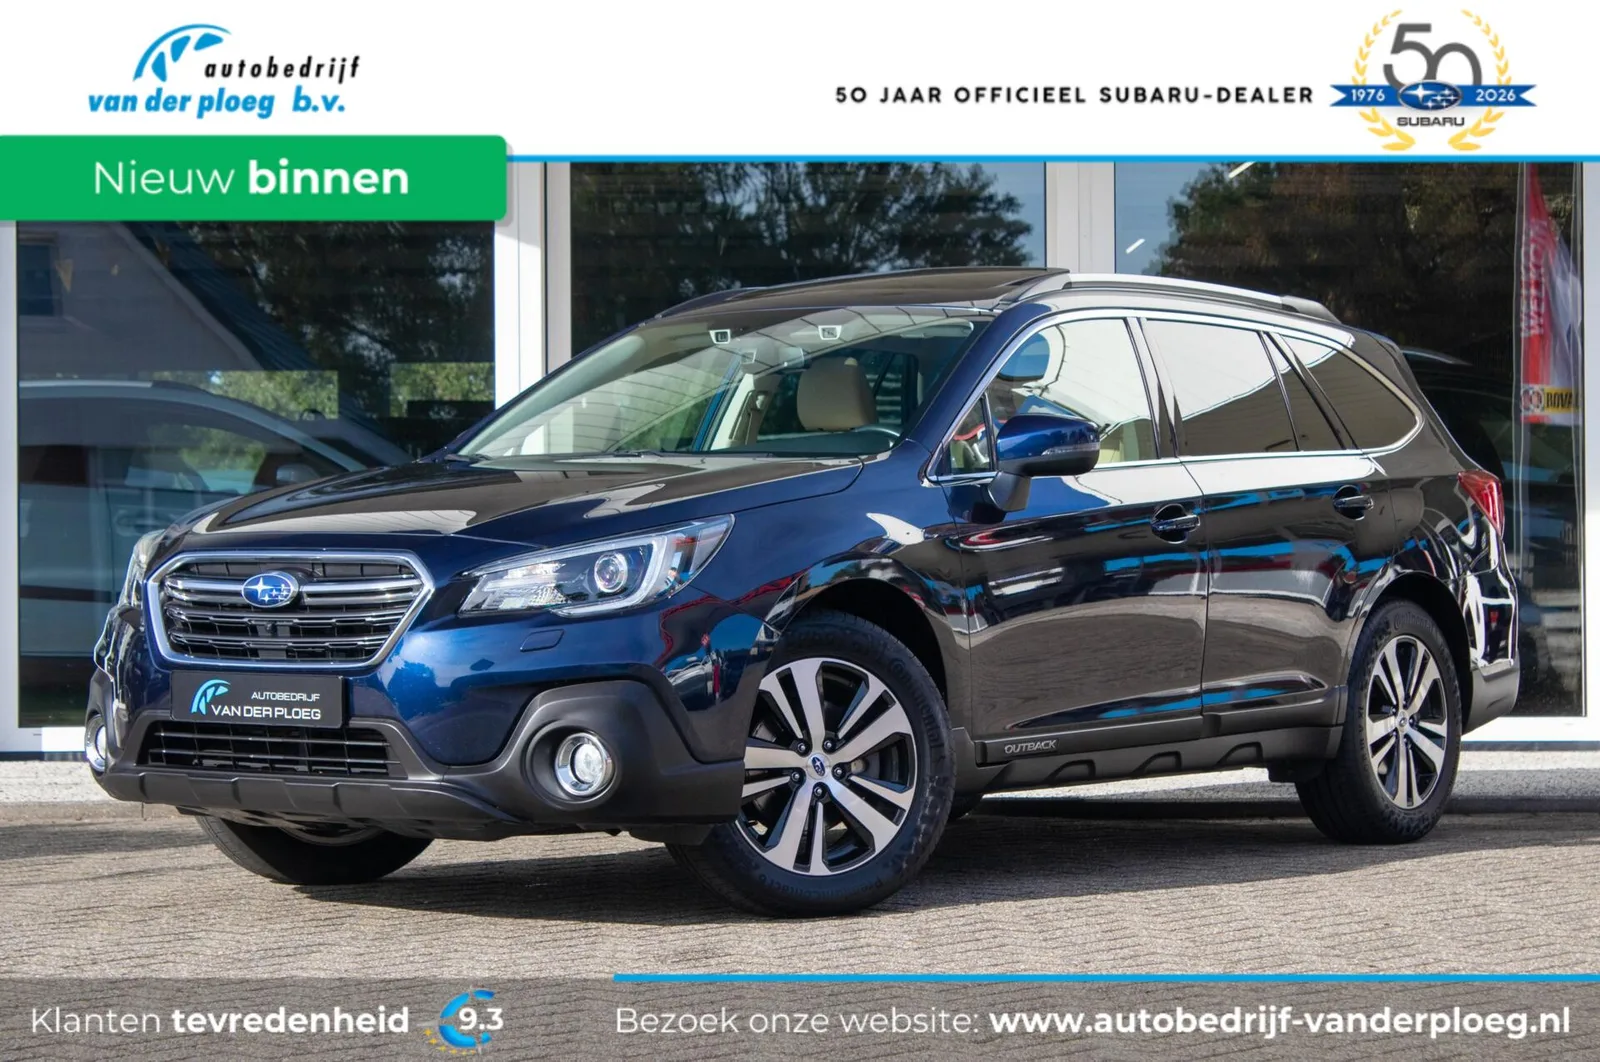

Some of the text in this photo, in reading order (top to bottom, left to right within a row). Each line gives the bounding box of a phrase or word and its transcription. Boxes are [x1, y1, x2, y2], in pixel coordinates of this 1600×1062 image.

[251, 691, 321, 702] AUTOBEDRIJF
[211, 704, 322, 720] VAN DER PLOEG
[1004, 739, 1057, 754] OUTBACK
